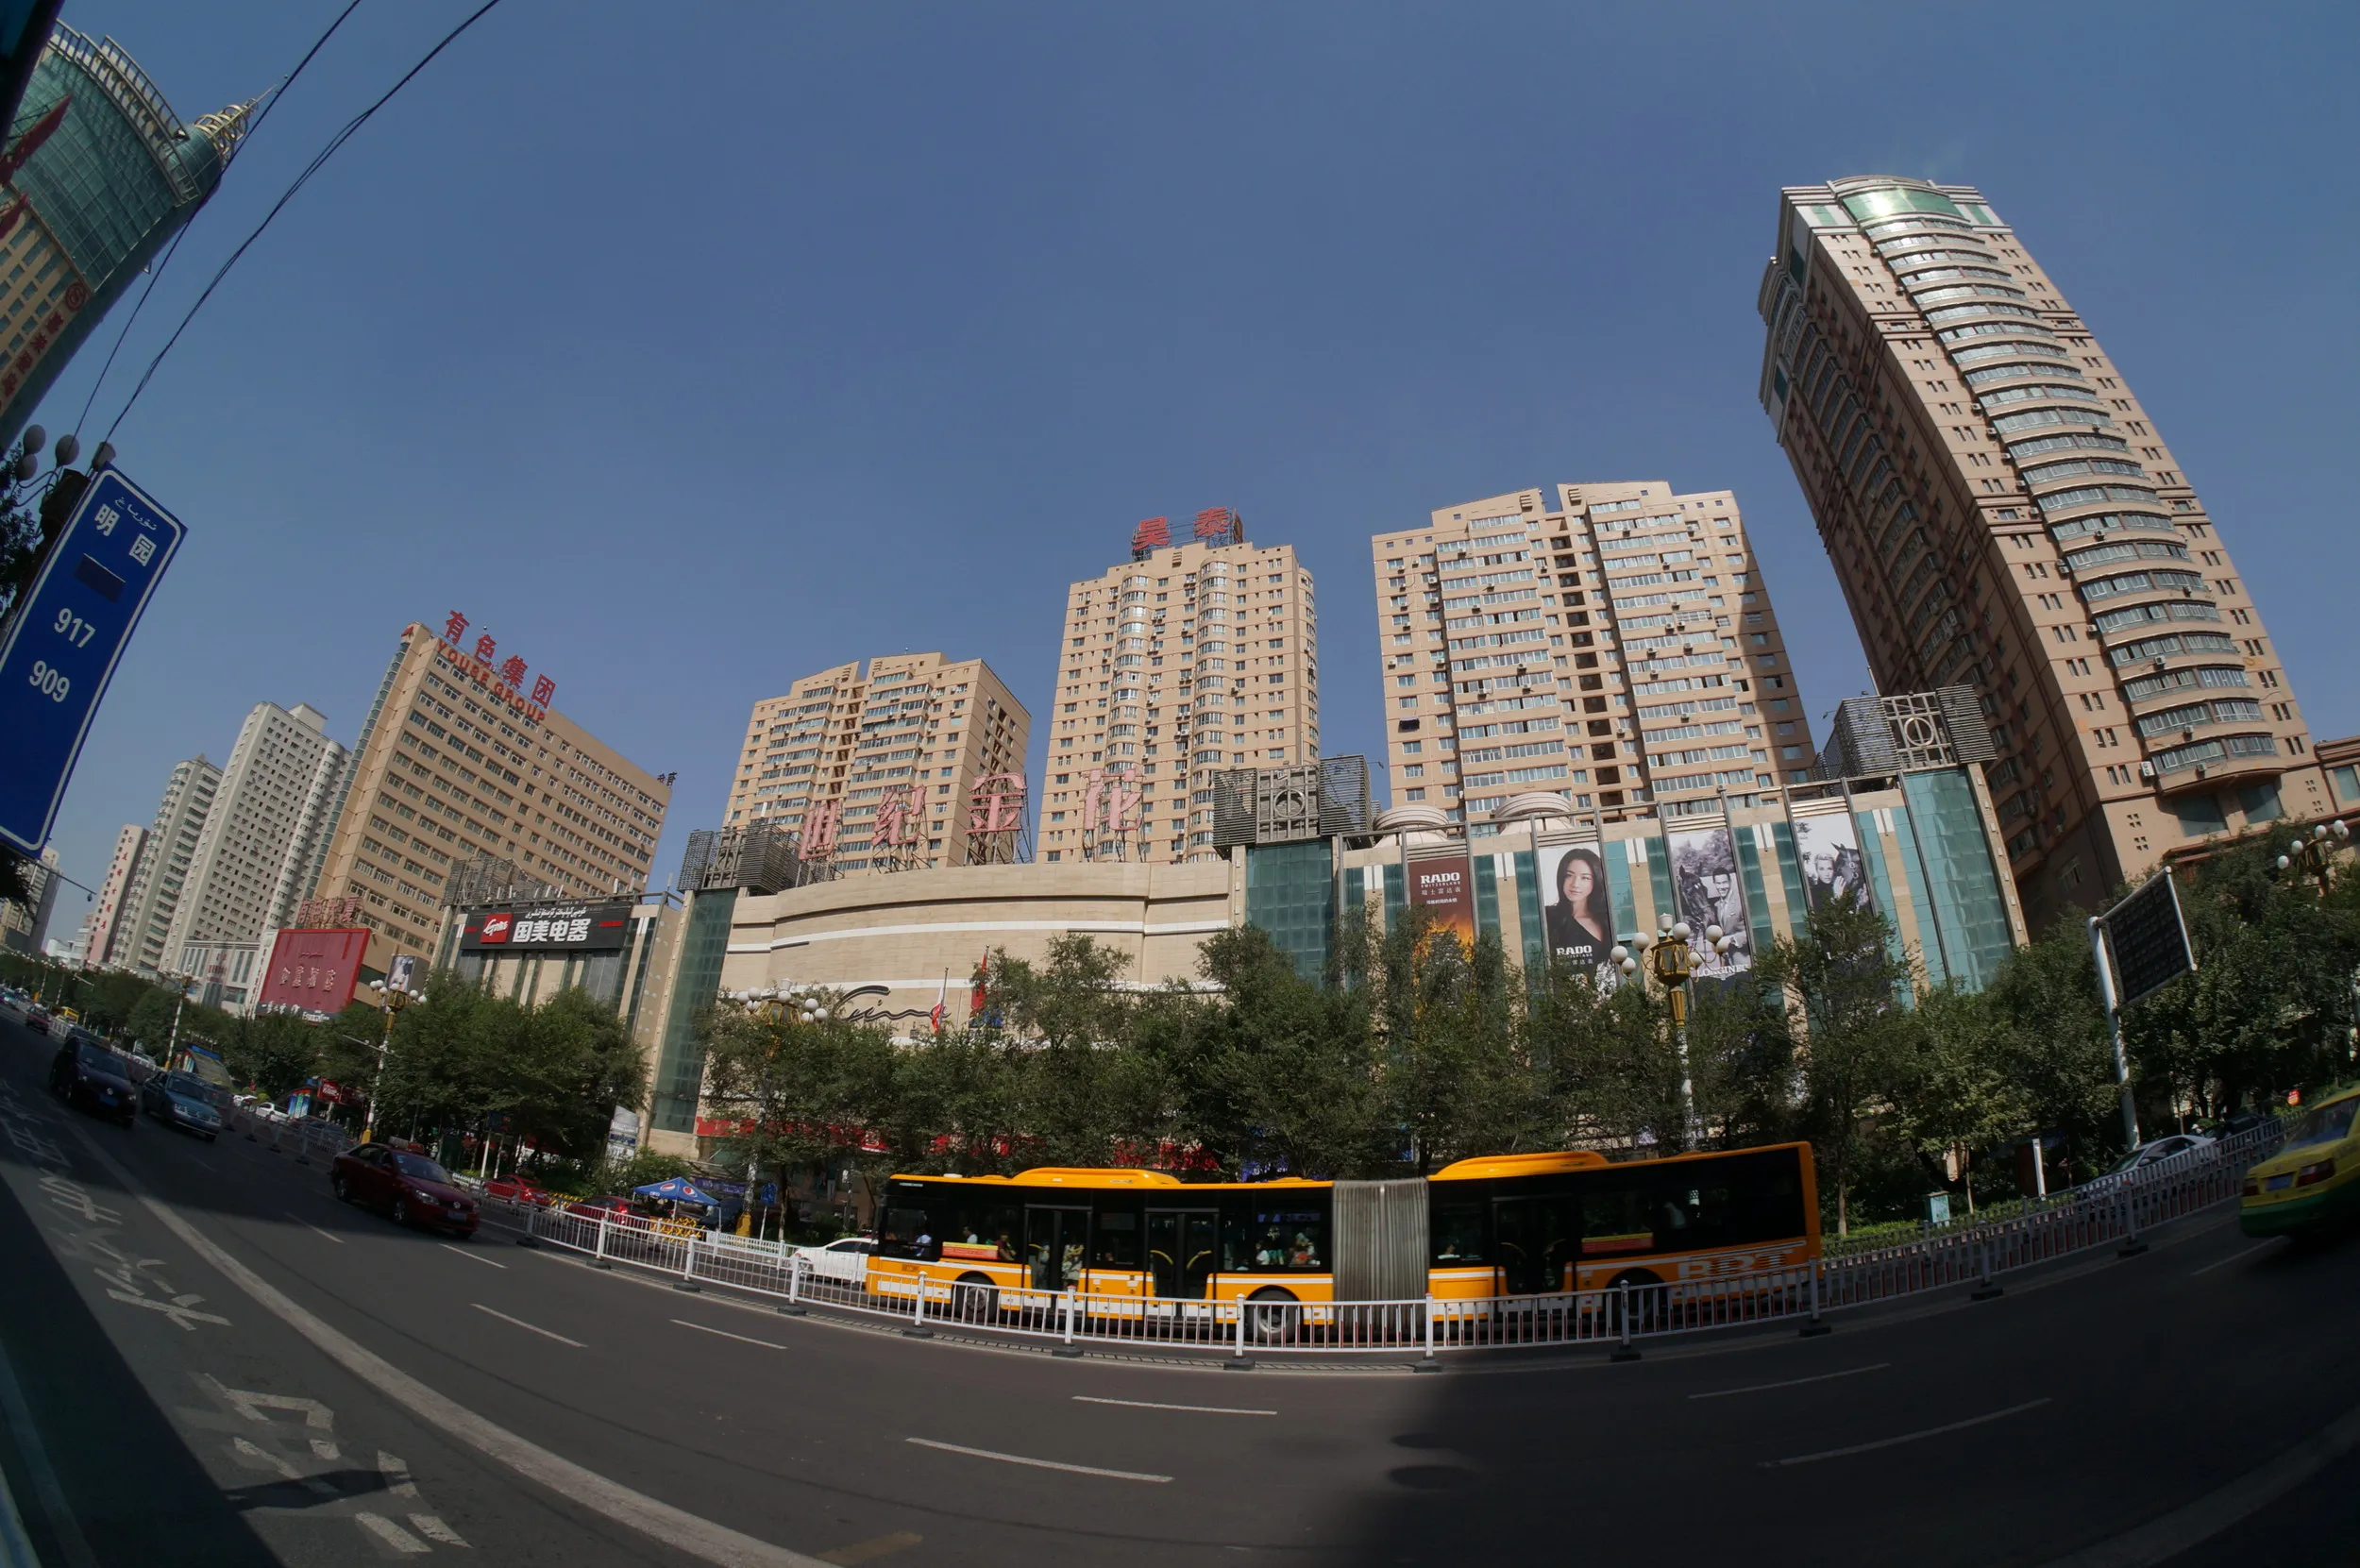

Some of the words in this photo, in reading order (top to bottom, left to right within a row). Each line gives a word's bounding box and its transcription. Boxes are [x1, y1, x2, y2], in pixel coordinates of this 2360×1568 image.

[94, 502, 158, 567] 明园
[1133, 507, 1231, 550] 昊泰
[54, 607, 96, 649] 917
[437, 638, 491, 685] YOUSE
[493, 681, 546, 723] GROUP
[446, 610, 557, 709] 有色集团
[28, 660, 71, 703] 909
[799, 767, 1144, 861] 世纪金花
[1420, 871, 1461, 885] RADO
[513, 919, 591, 943] 国美电器
[1556, 945, 1593, 956] RADO
